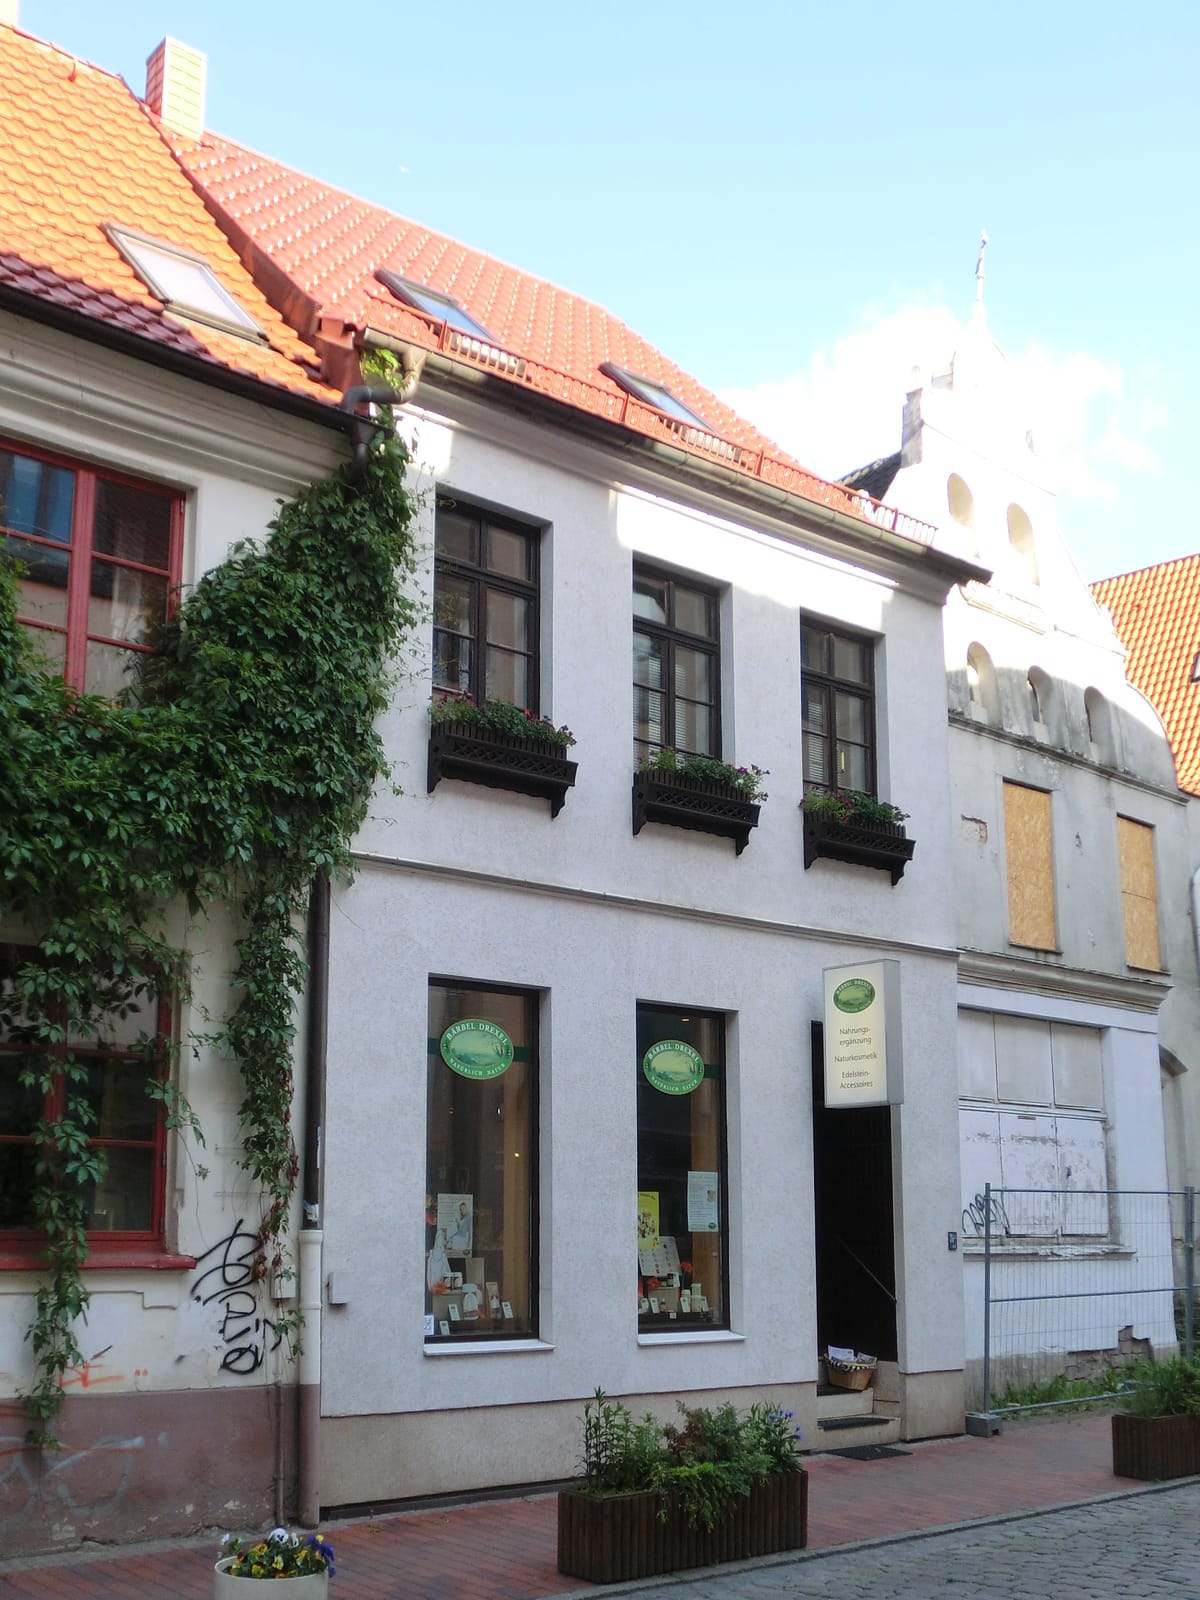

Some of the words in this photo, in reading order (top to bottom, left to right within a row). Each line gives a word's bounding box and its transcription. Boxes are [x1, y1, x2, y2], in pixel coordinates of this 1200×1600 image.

[479, 1023, 508, 1046] DREXEL
[839, 1026, 871, 1036] Nahrungs-
[834, 1052, 878, 1063] Naturkosmetik
